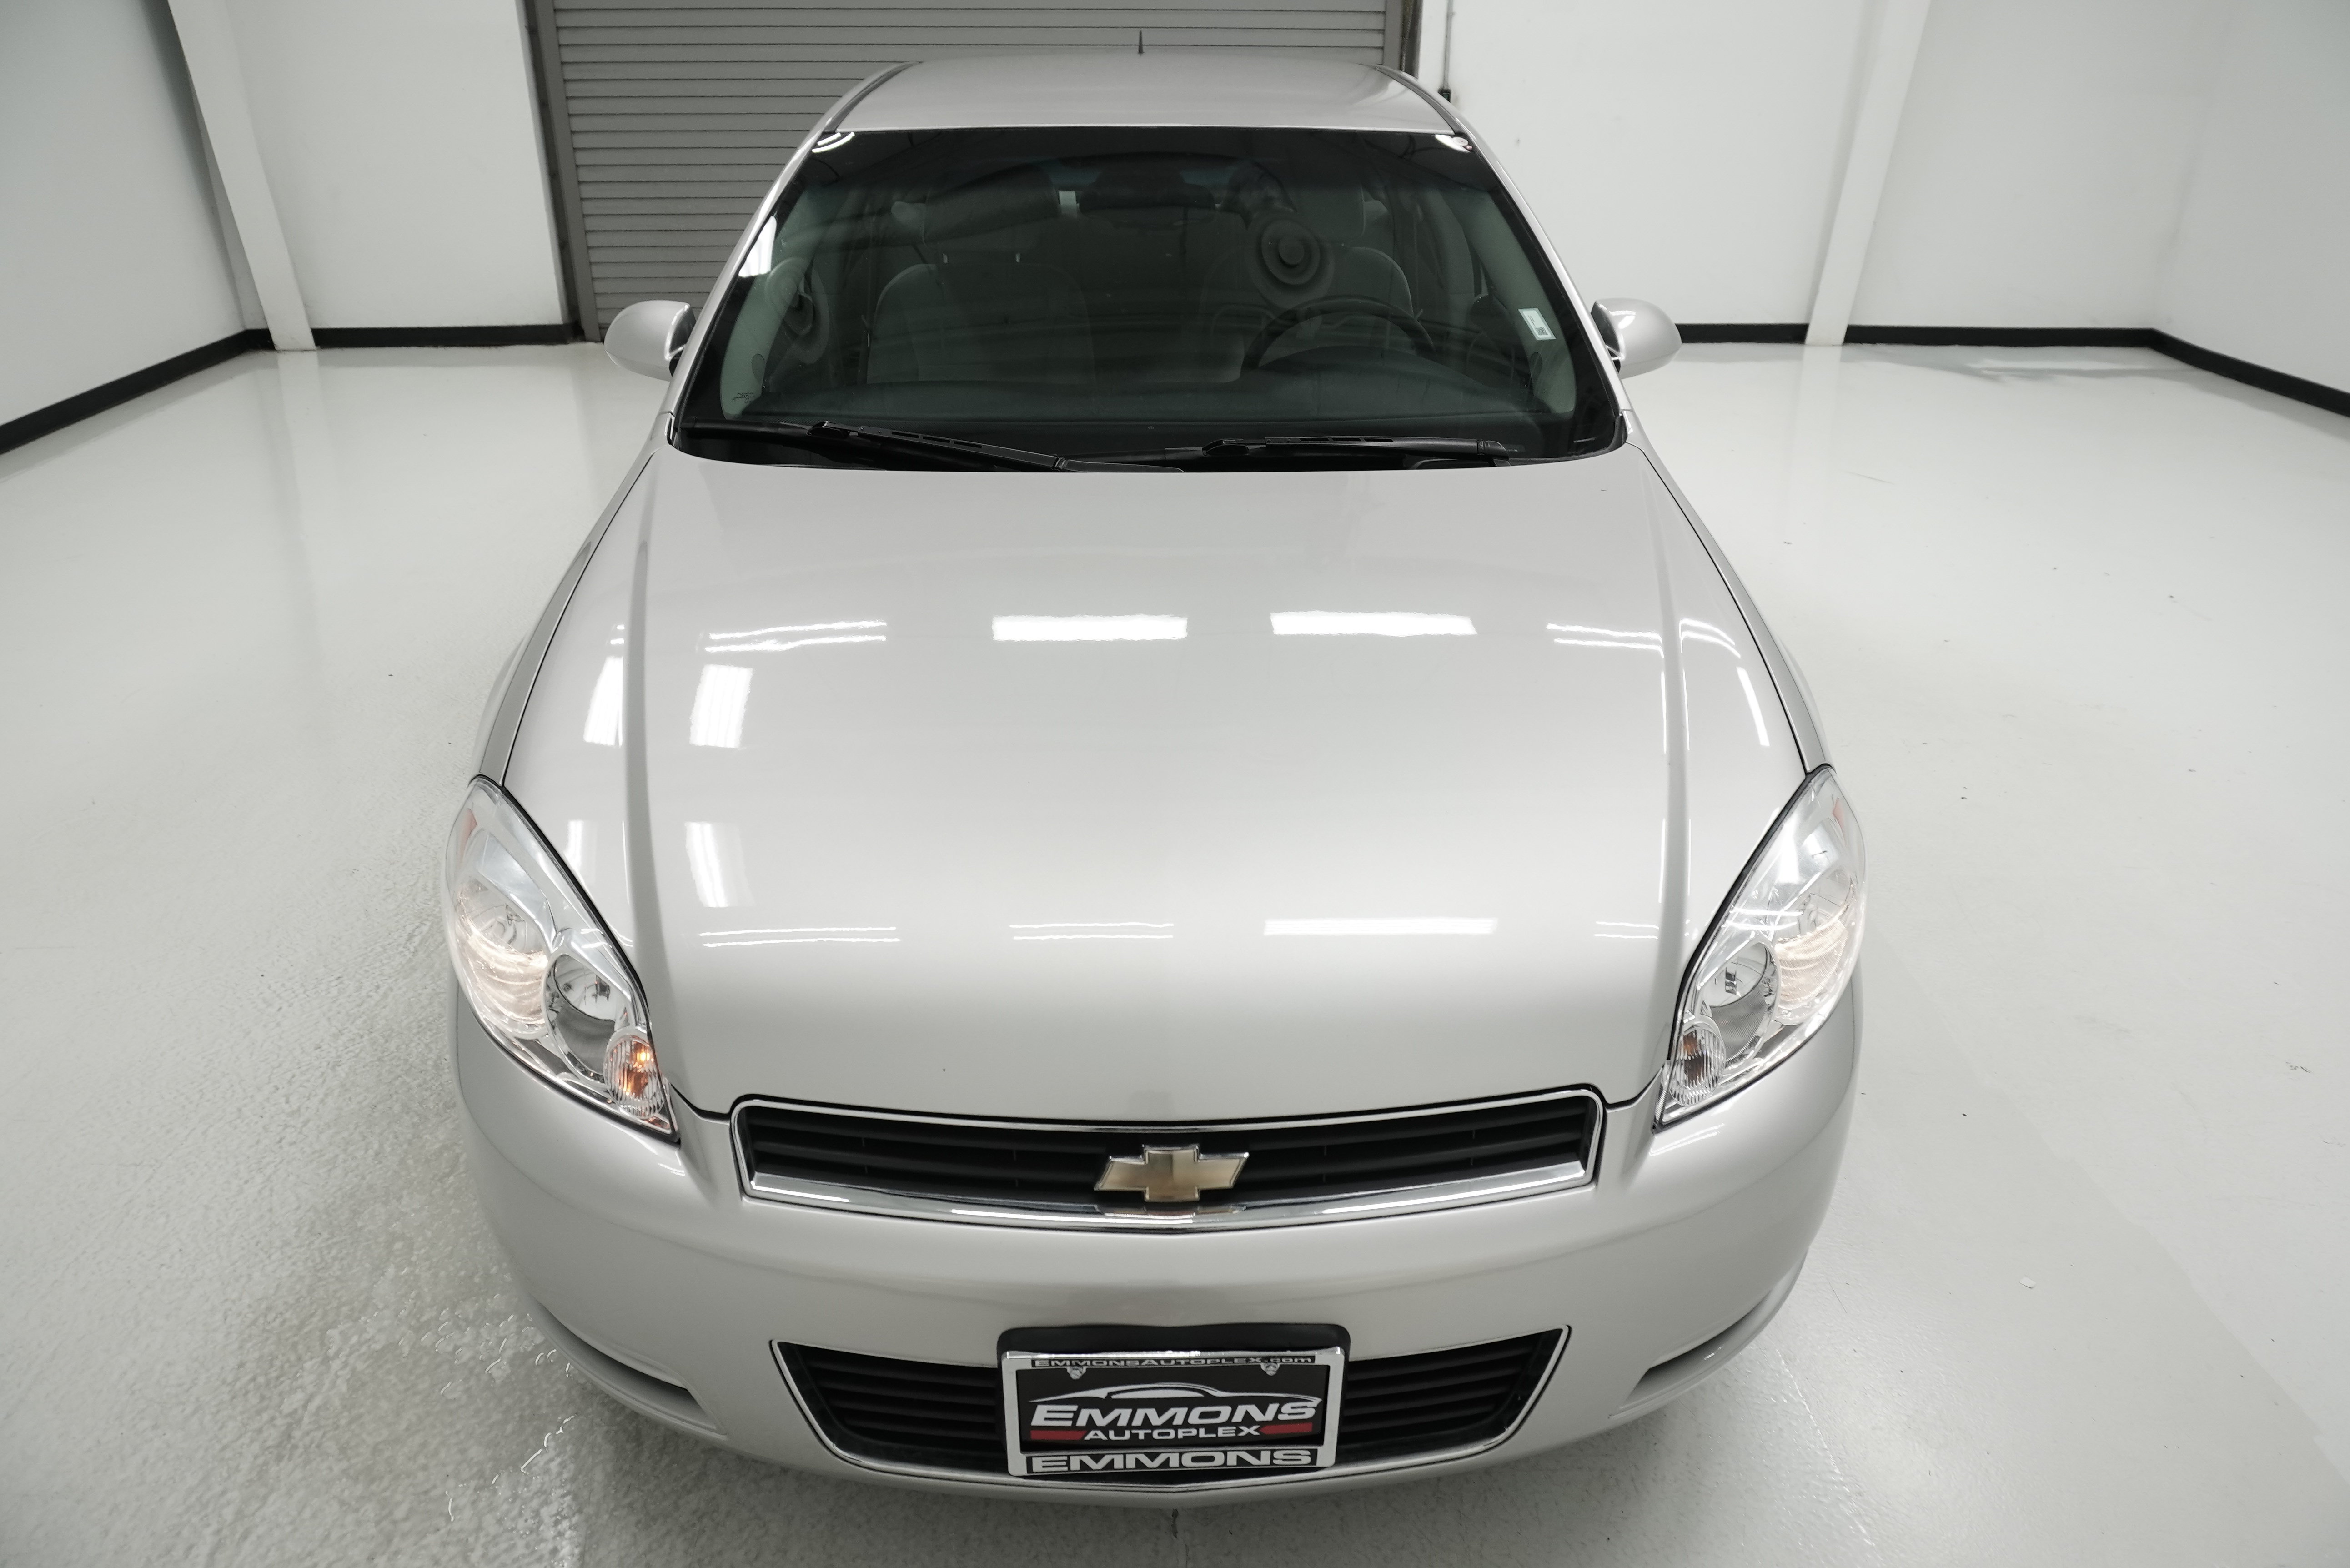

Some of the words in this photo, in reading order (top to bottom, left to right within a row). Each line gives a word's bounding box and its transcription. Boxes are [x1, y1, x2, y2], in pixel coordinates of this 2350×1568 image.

[1031, 1401, 1317, 1427] EMMONS
[1084, 1425, 1260, 1440] AUTOPLEX
[1032, 1450, 1311, 1473] EMMONS
